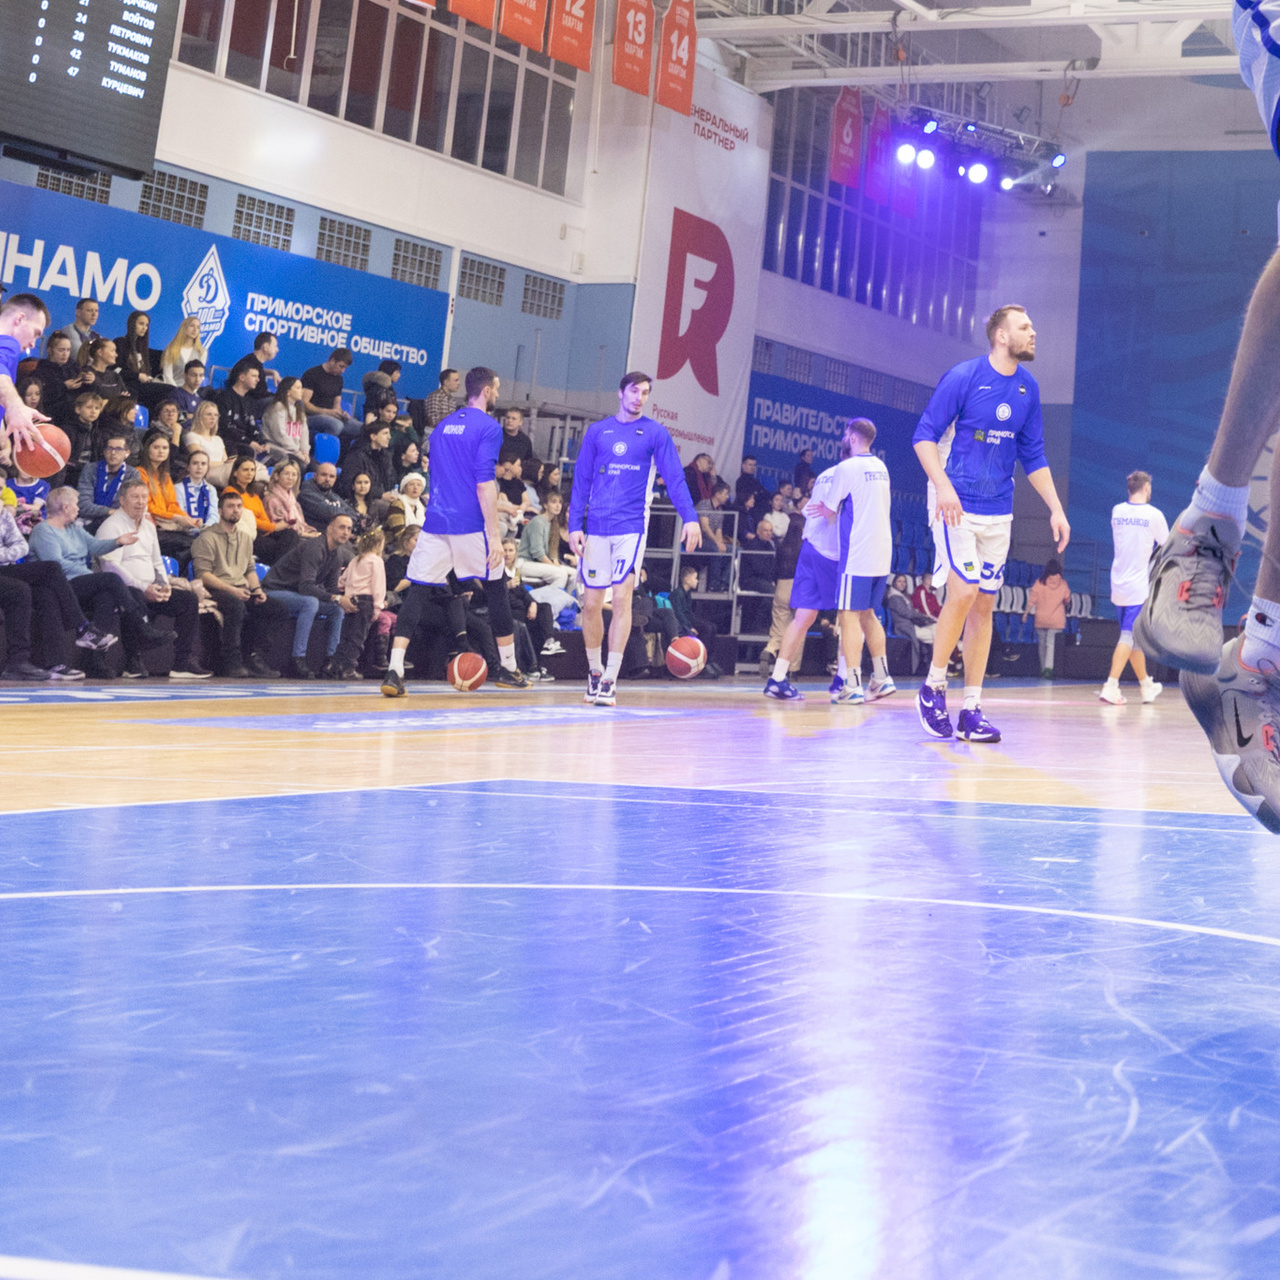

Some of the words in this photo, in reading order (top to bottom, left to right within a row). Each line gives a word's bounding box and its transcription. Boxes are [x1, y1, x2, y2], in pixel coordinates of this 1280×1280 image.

[109, 24, 152, 47] ПЕТРОВИЧ
[122, 10, 155, 30] ВОЙТОВ
[626, 8, 647, 45] 13
[108, 41, 149, 64] ТУКМАКОВ
[670, 29, 689, 66] 14
[109, 61, 147, 82] ТУМАНОВ
[101, 77, 144, 98] КУРЦЕВИЧ
[691, 104, 749, 143] ЕНЕРАЛЬНЫЙ
[693, 123, 736, 151] ПАРТНЕР
[843, 118, 852, 144] 6
[0, 231, 161, 311] НАМО
[246, 292, 352, 330] ПРИМОРСКОЕ
[244, 313, 348, 348] СПОРТИВНОЕ
[351, 335, 427, 366] ОБЩЕСТВО
[652, 403, 678, 420] Русская
[754, 397, 850, 436] ПРАВИТЕЛЬСТ
[751, 425, 843, 460] ПРИМОРСКОГ
